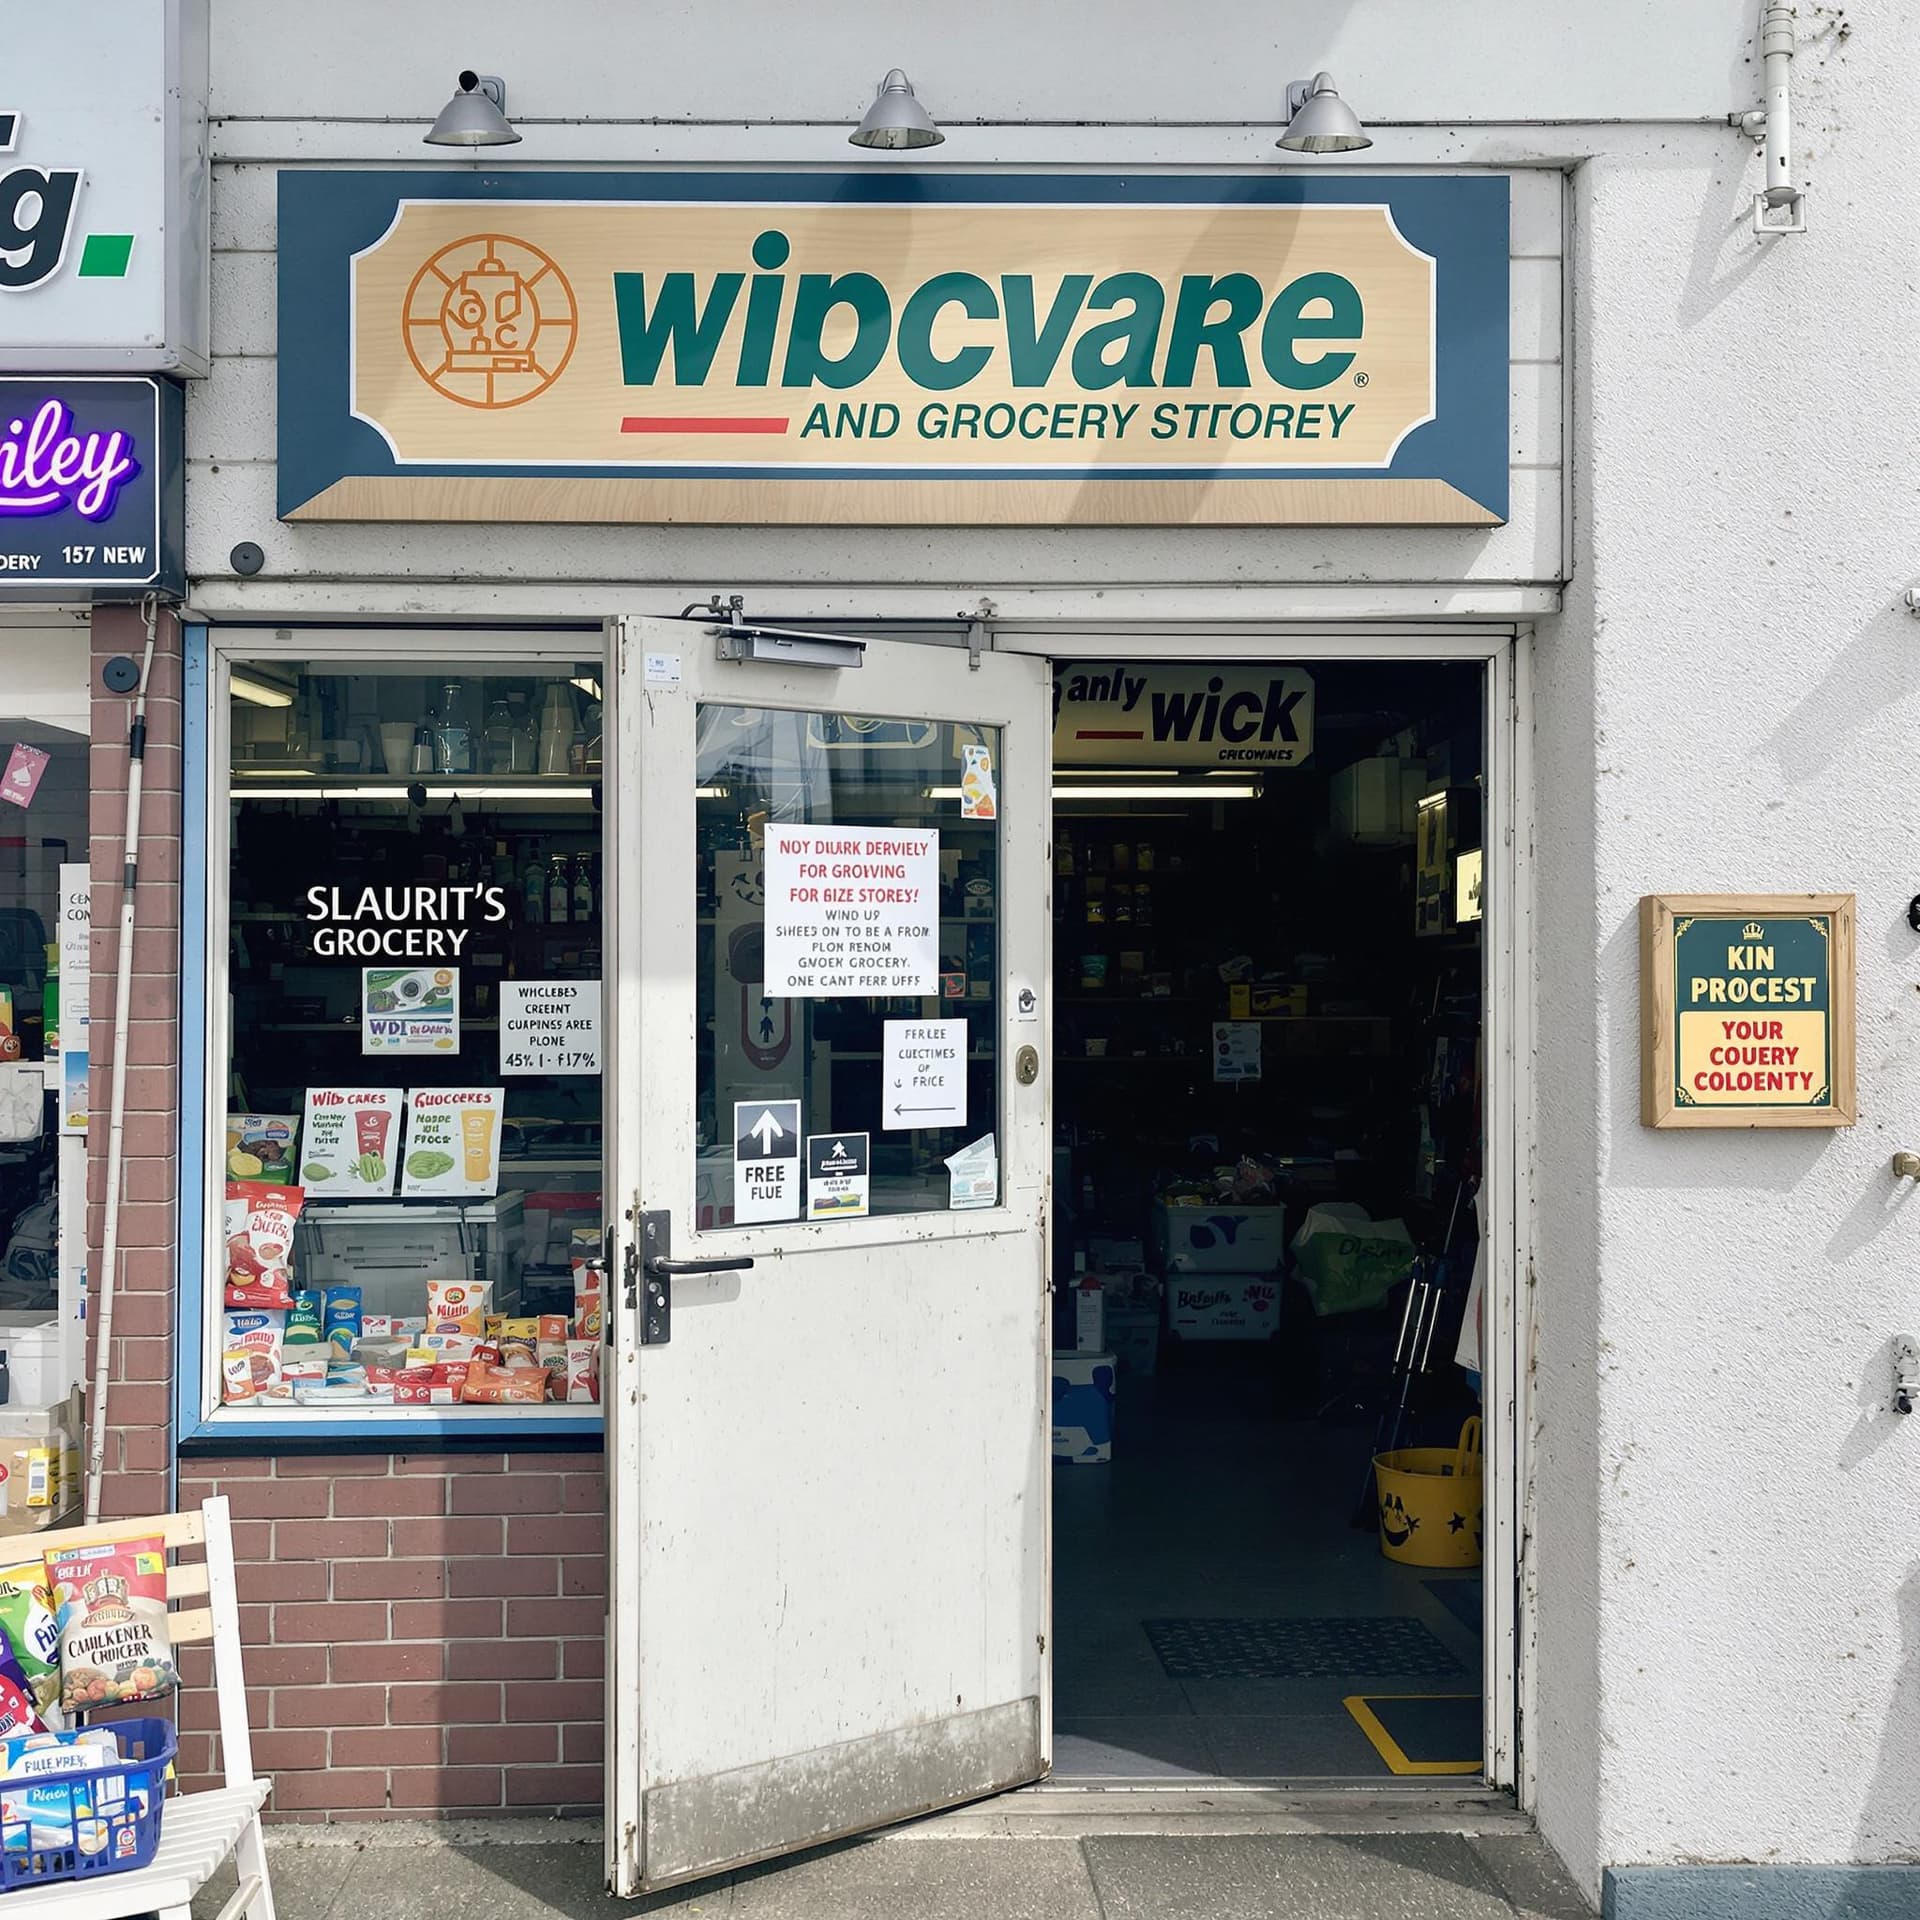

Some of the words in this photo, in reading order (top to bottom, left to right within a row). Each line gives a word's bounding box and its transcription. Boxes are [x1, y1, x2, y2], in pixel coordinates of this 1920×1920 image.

[801, 404, 901, 438] AND
[918, 403, 1139, 440] GROCERY
[61, 545, 96, 564] 157
[103, 546, 147, 564] NEW
[1151, 676, 1307, 743] wick
[779, 840, 811, 855] NOY
[799, 864, 828, 878] FOR
[306, 882, 506, 921] SLAURIT'S
[789, 887, 819, 902] FOR
[825, 909, 859, 921] WIND
[822, 926, 840, 937] ON
[845, 926, 862, 937] TO
[865, 926, 880, 937] BE
[883, 926, 893, 937] A
[313, 929, 469, 957] GROCERY
[1727, 945, 1775, 970] KIN
[787, 975, 815, 987] ONE
[820, 975, 855, 987] CANT
[1691, 977, 1817, 1003] PROCEST
[1721, 1021, 1784, 1040] YOUR
[529, 1035, 566, 1047] PLONE
[1709, 1046, 1800, 1066] COUERY
[1693, 1071, 1814, 1092] COLOENTY
[745, 1165, 785, 1183] FREE
[751, 1185, 782, 1200] FLUE
